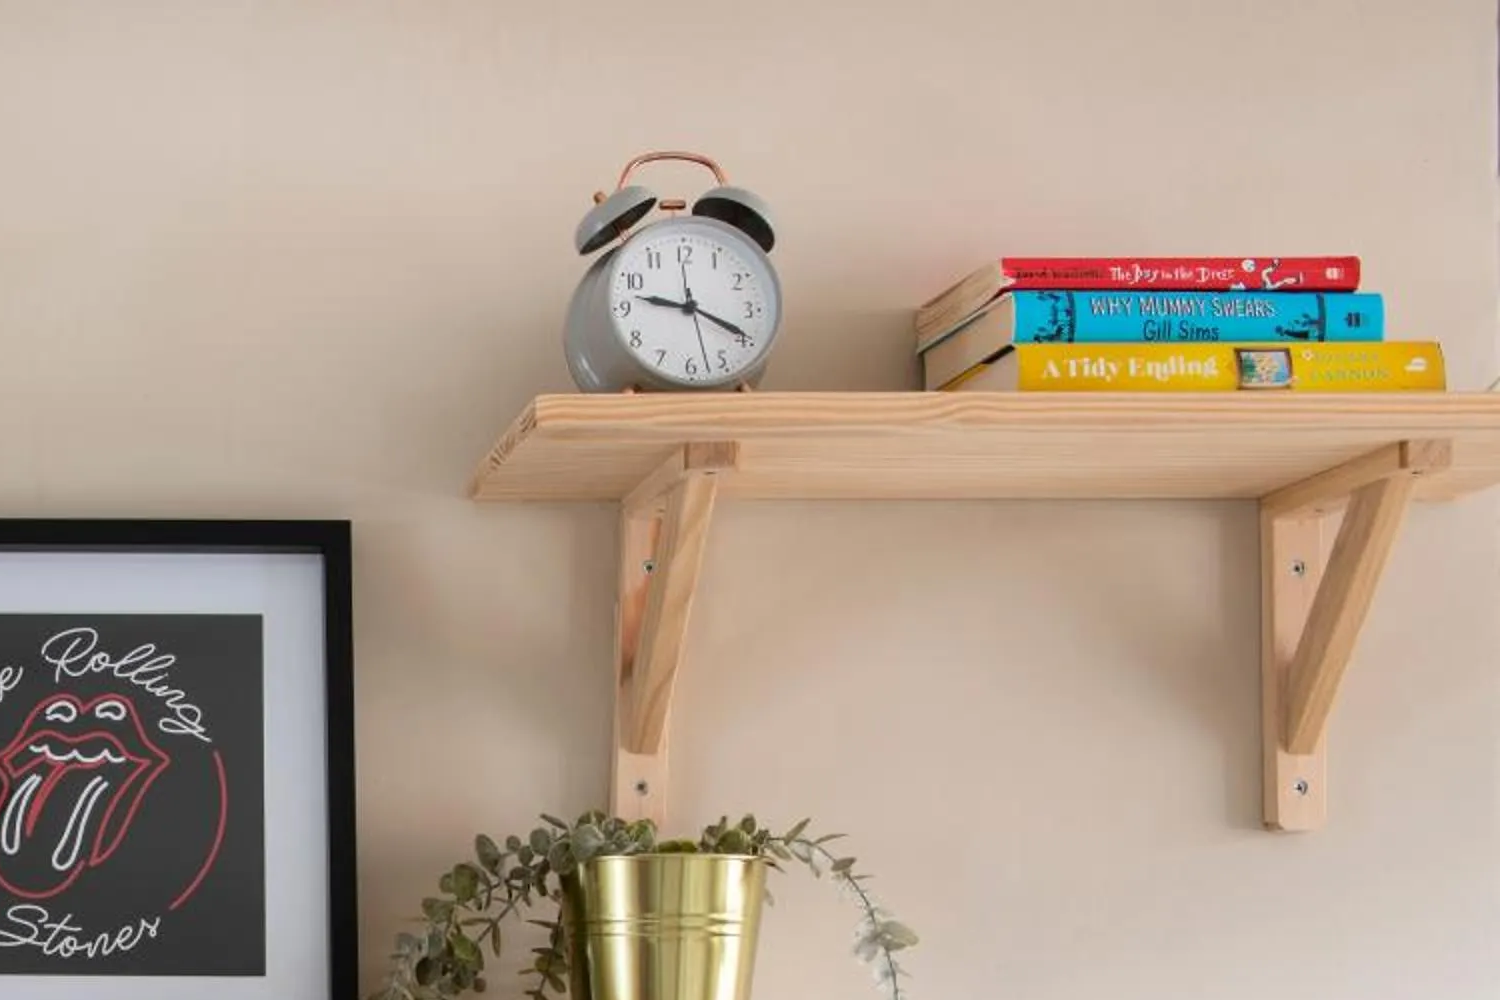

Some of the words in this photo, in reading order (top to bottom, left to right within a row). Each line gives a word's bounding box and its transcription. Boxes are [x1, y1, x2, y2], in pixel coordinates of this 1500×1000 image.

[647, 252, 661, 269] 11
[676, 245, 694, 265] 12
[626, 273, 645, 291] 10
[732, 273, 742, 291] 2
[1109, 266, 1132, 281] The
[619, 301, 632, 318] 9
[744, 302, 753, 319] 3
[1090, 296, 1133, 317] WHY
[1138, 296, 1207, 318] MUMMY
[1211, 297, 1277, 318] SWEARS
[630, 330, 642, 348] 8
[1142, 319, 1172, 341] Gill
[1178, 319, 1221, 341] Sims
[655, 350, 666, 367] 7
[685, 357, 698, 376] 6
[717, 350, 727, 369] 5
[1041, 358, 1062, 380] A
[1062, 356, 1120, 384] Tidy
[1128, 355, 1220, 382] Ending
[40, 626, 213, 744] Rolling
